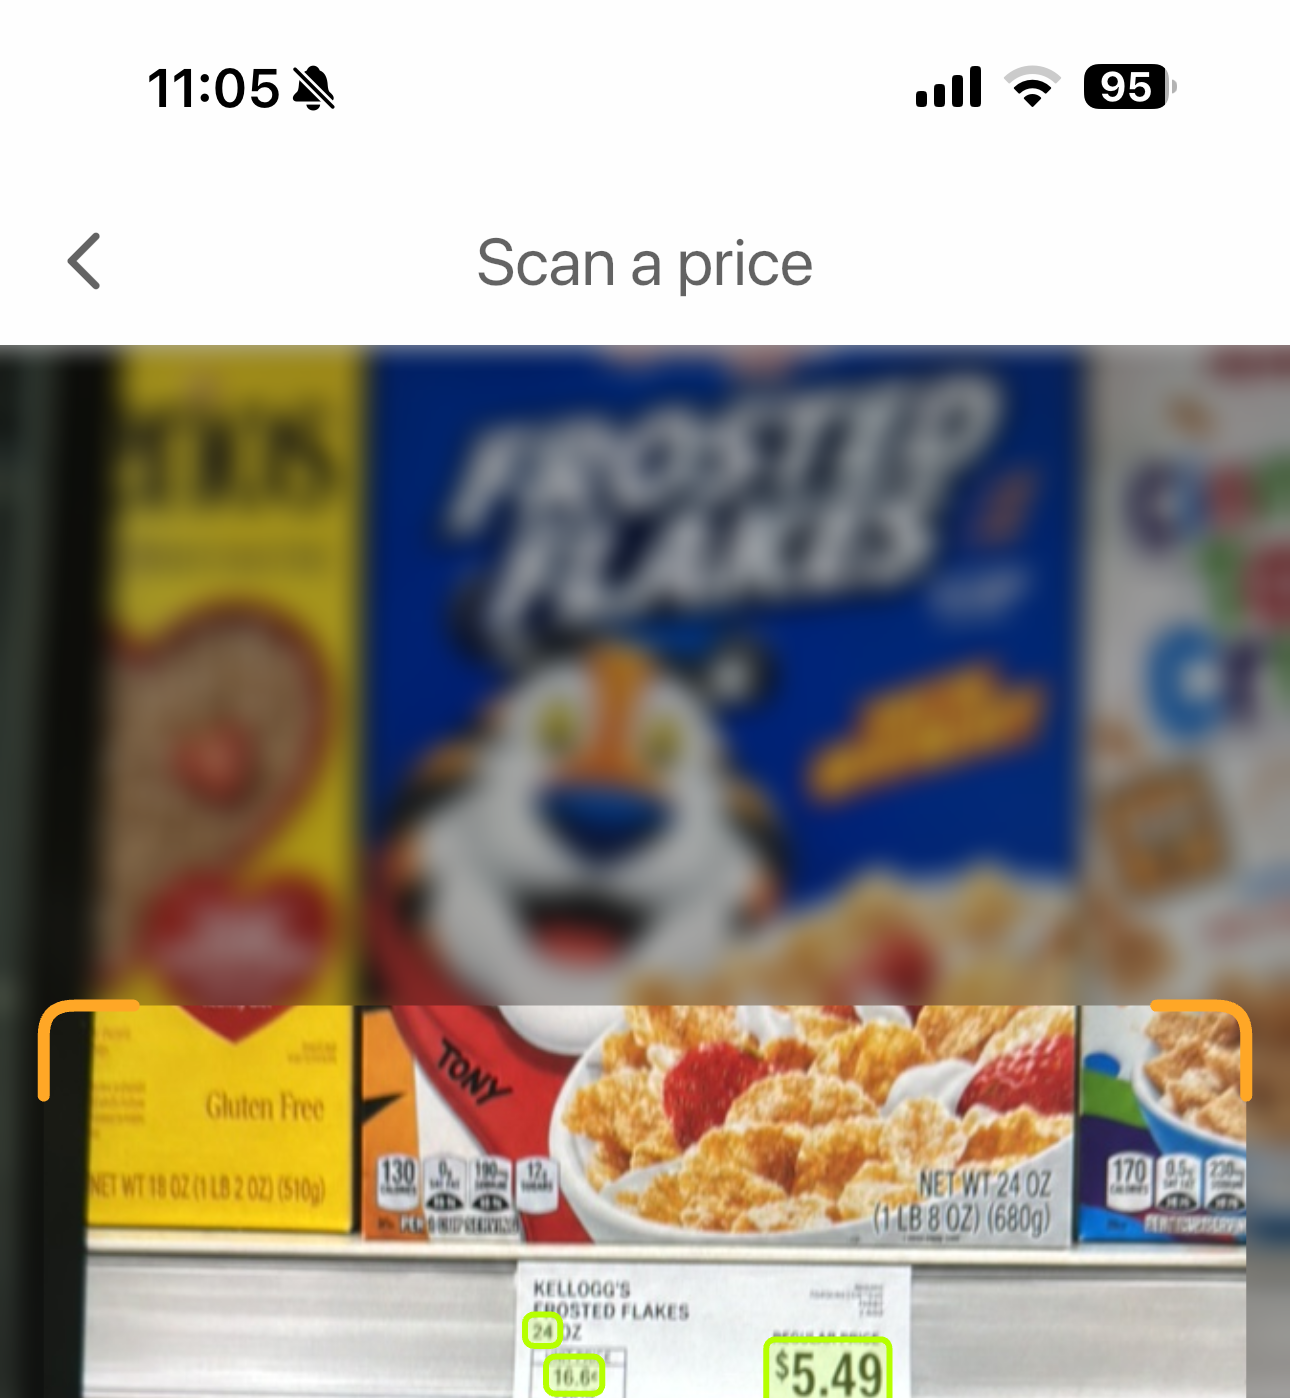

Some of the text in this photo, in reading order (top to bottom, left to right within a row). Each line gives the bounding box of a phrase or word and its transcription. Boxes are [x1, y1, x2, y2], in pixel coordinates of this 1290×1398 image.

[149, 68, 279, 108] 11:05
[1101, 71, 1151, 102] 95
[479, 238, 812, 296] Scan a price
[438, 1037, 513, 1106] TONY
[206, 1091, 324, 1121] Gluten Free
[383, 1158, 414, 1184] 130
[920, 1170, 1052, 1197] NET WT 24 OZ
[1114, 1158, 1146, 1182] 170
[90, 1172, 118, 1199] NET
[121, 1173, 145, 1200] WT
[149, 1174, 167, 1200] 18
[170, 1174, 190, 1200] OZ
[234, 1176, 244, 1201] 2
[248, 1175, 273, 1203] OZ)
[278, 1175, 325, 1207] (510g)
[873, 1202, 1051, 1237] (1 LB 8 OZ) (680g)
[533, 1279, 631, 1299] KELLOGG'S
[621, 1303, 690, 1321] FLAKES
[532, 1323, 553, 1342] 24
[775, 1349, 883, 1398] $5.49
